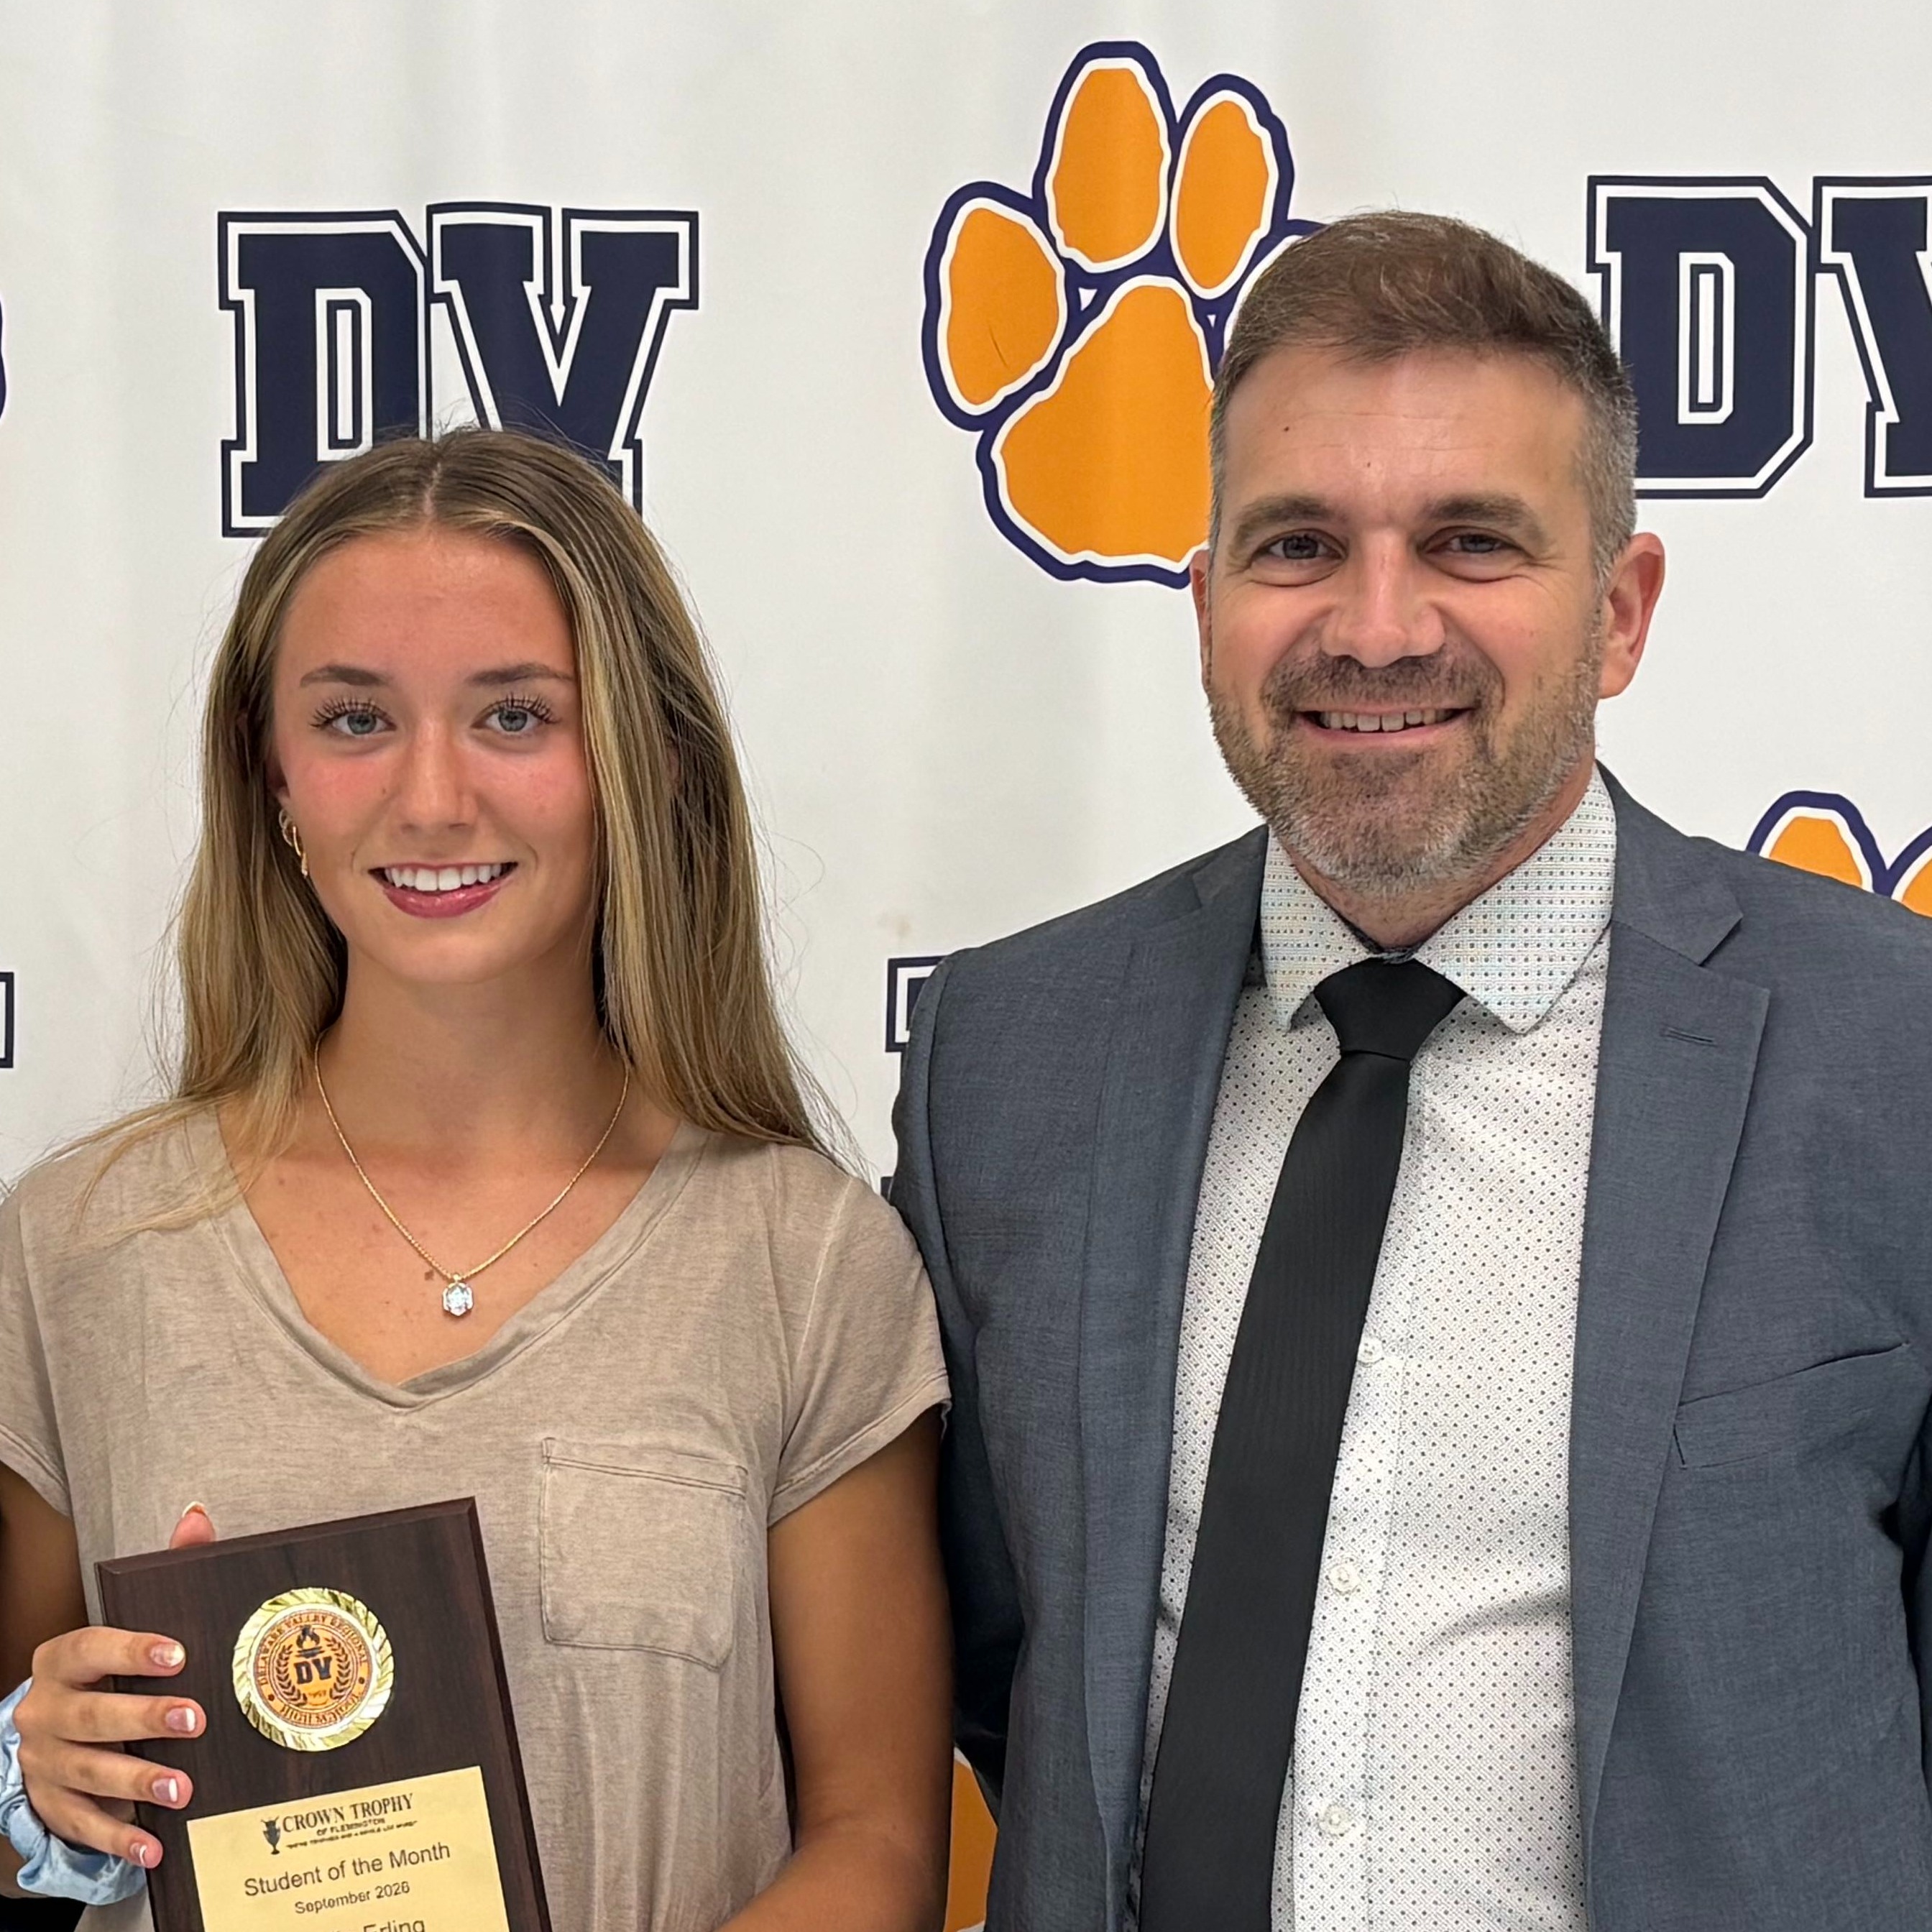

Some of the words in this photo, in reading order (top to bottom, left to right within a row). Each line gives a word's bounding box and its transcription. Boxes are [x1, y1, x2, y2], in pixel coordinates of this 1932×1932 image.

[218, 202, 699, 537] DV
[257, 1627, 283, 1685] DELAWARE
[284, 1614, 326, 1627] VALLEY
[330, 1617, 367, 1667] REGIONAL
[294, 1656, 333, 1685] DV
[280, 1704, 312, 1724] HIGH
[282, 1806, 345, 1832] CROWN
[349, 1793, 413, 1819] TROPHY
[316, 1828, 327, 1836] OF
[330, 1818, 385, 1833] FLEMINGTON
[244, 1867, 323, 1896] Student
[328, 1860, 346, 1881] of
[352, 1857, 383, 1876] the
[388, 1842, 451, 1869] Month
[295, 1891, 370, 1914] September
